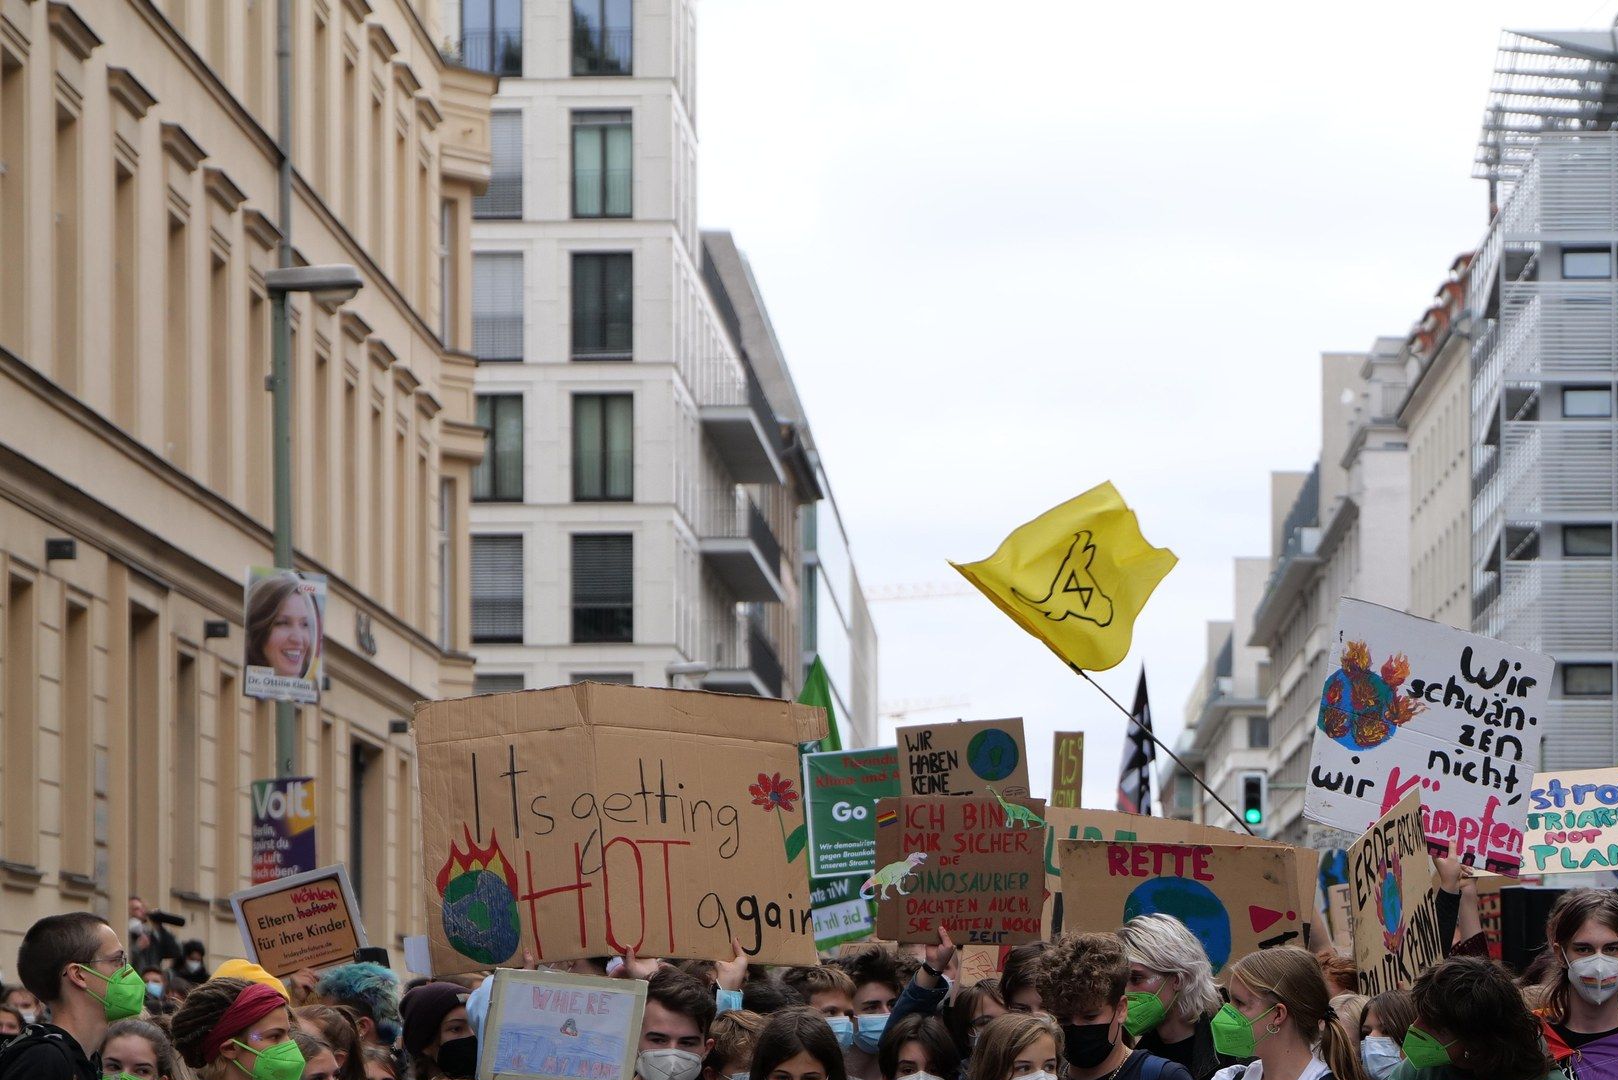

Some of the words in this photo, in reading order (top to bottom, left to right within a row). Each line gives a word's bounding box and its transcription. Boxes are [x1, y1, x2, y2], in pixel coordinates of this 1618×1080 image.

[1460, 646, 1537, 697] Wir
[905, 730, 932, 752] WIR
[909, 750, 959, 775] HABEN
[911, 773, 951, 796] KEINE
[1311, 755, 1375, 798] wir
[1428, 749, 1522, 806] nicht,
[252, 782, 312, 820] Volt
[832, 801, 868, 822] Go
[571, 757, 740, 876] getting
[905, 803, 945, 832] ICH
[962, 802, 1005, 831] BIN
[276, 838, 290, 851] du
[819, 842, 833, 850] Wir
[903, 832, 941, 853] MIR
[951, 832, 1033, 854] SICHER,
[1544, 828, 1602, 845] NOT
[264, 851, 283, 863] Luft
[819, 852, 842, 861] gegen
[843, 848, 876, 858] Braunkoh
[939, 855, 961, 866] DIE
[1107, 844, 1215, 882] RETTE
[1355, 819, 1396, 911] ERDE
[820, 862, 847, 870] unseren
[521, 836, 692, 960] HOT
[906, 899, 978, 915] DACHTEN
[988, 898, 1031, 915] AUCH,
[257, 912, 295, 930] Eltern
[907, 918, 934, 934] SIE
[1001, 918, 1042, 933] NOCH
[258, 937, 276, 951] für
[280, 931, 304, 945] ihre
[306, 917, 347, 936] Kinder
[968, 931, 1009, 943] ZEIT
[531, 986, 612, 1015] WHERE
